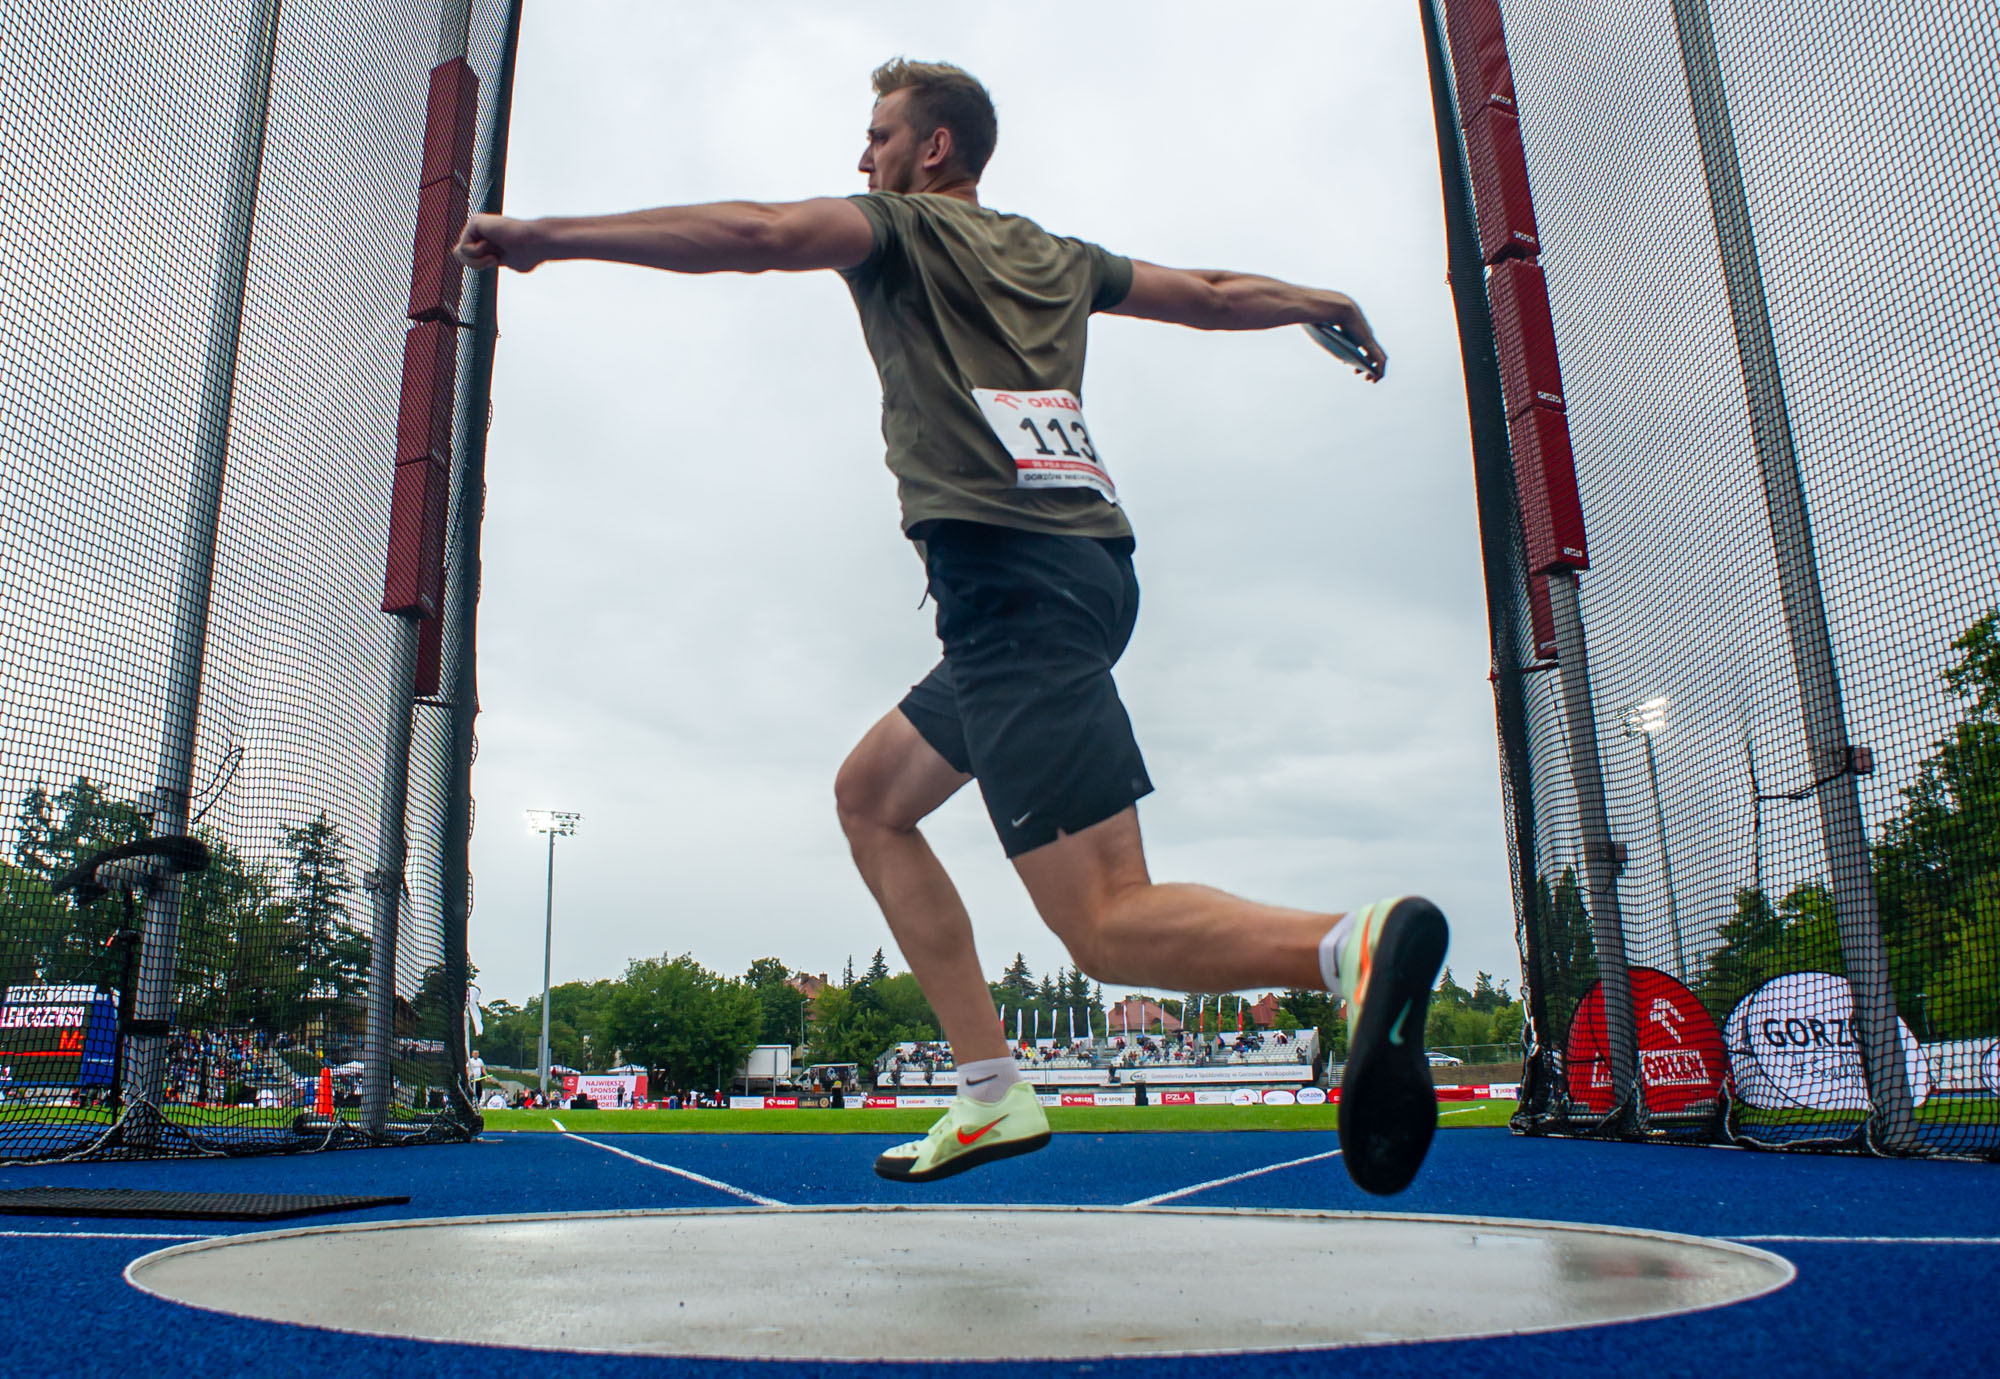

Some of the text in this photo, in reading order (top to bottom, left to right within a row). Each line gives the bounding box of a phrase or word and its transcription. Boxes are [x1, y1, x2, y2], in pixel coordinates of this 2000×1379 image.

[1019, 417, 1097, 463] 113
[1763, 1017, 1865, 1047] GORZ
[1165, 1093, 1191, 1101] PZLA
